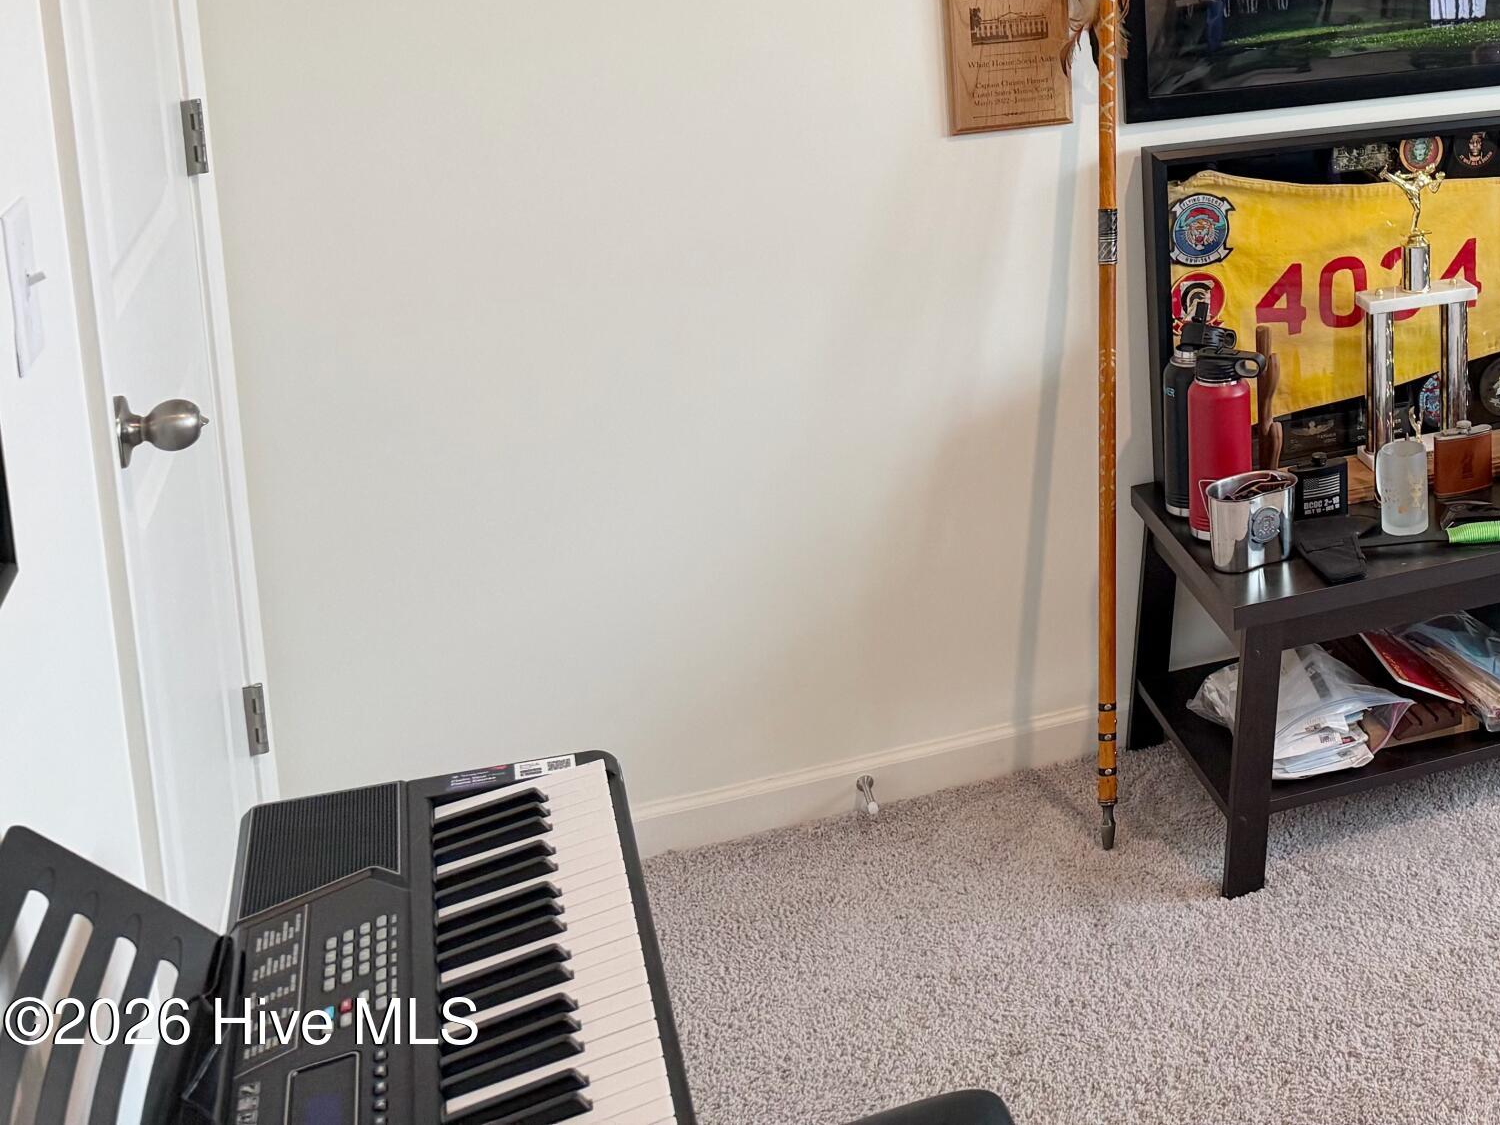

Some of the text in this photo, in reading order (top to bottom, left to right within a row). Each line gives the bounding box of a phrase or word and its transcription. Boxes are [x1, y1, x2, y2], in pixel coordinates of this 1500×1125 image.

[967, 58, 990, 68] White
[991, 59, 1014, 68] House
[1182, 195, 1223, 208] FLYING TIGERS
